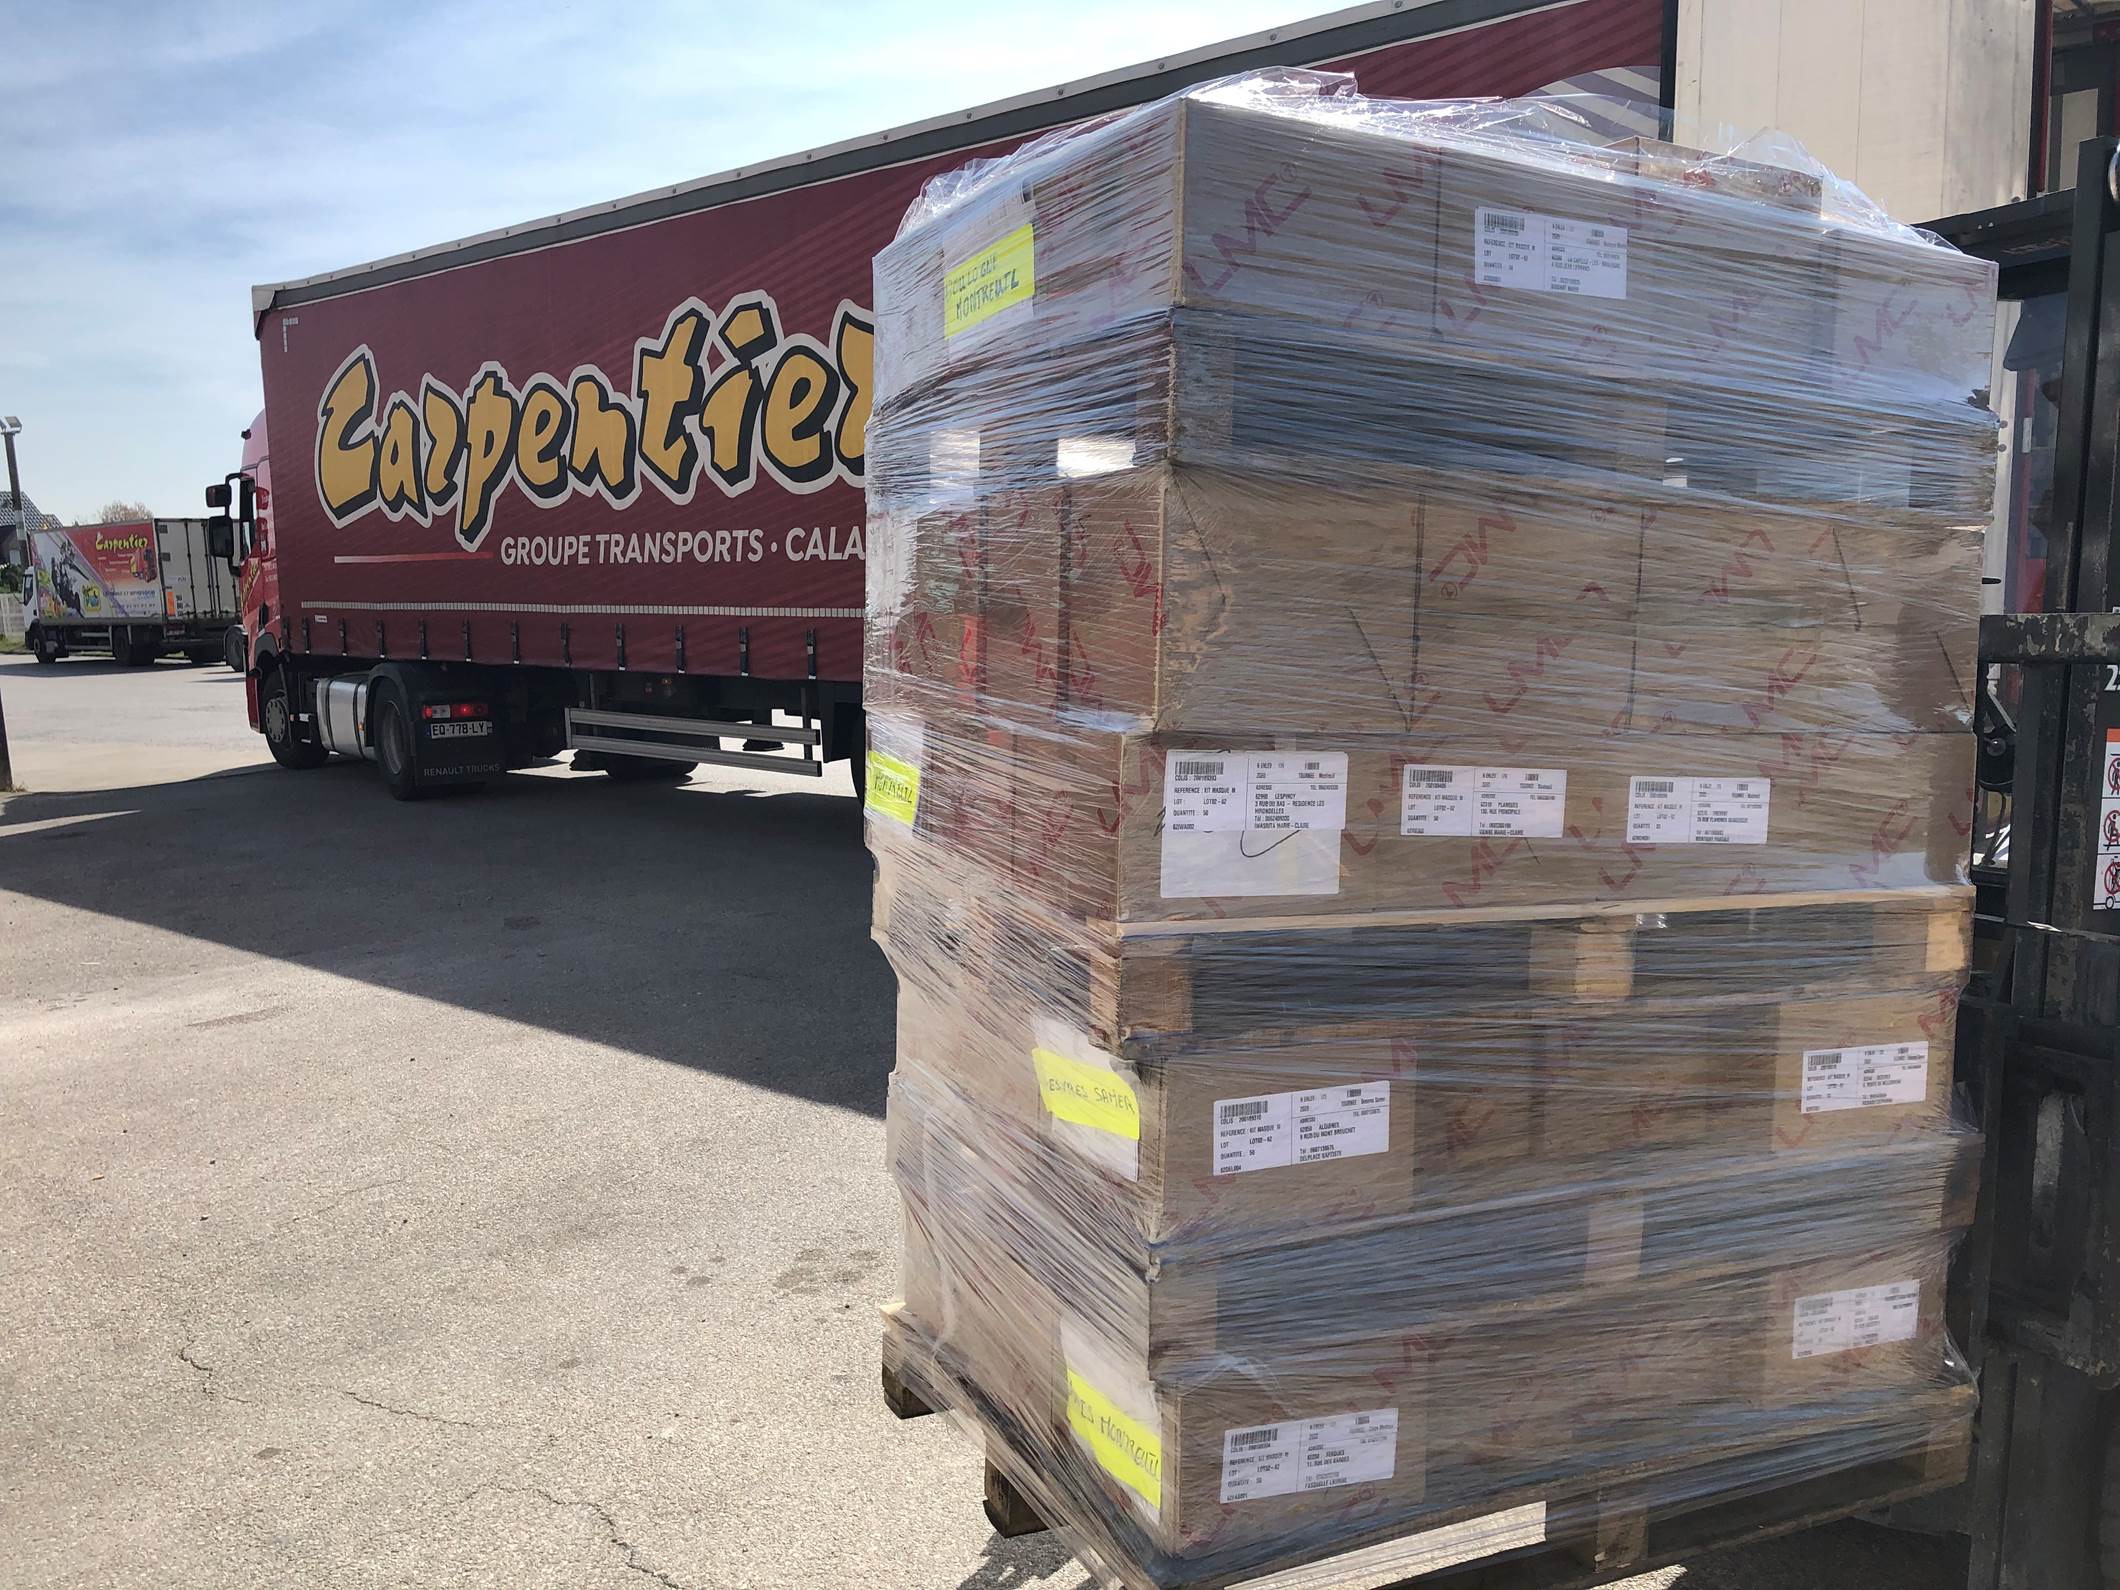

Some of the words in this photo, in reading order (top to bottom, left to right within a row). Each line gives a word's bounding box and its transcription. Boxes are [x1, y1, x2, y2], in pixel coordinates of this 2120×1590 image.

[500, 532, 591, 566] GROUPE
[596, 527, 763, 564] TRANSPORTS
[424, 765, 464, 777] RENAULT
[466, 763, 500, 775] TRUCKS
